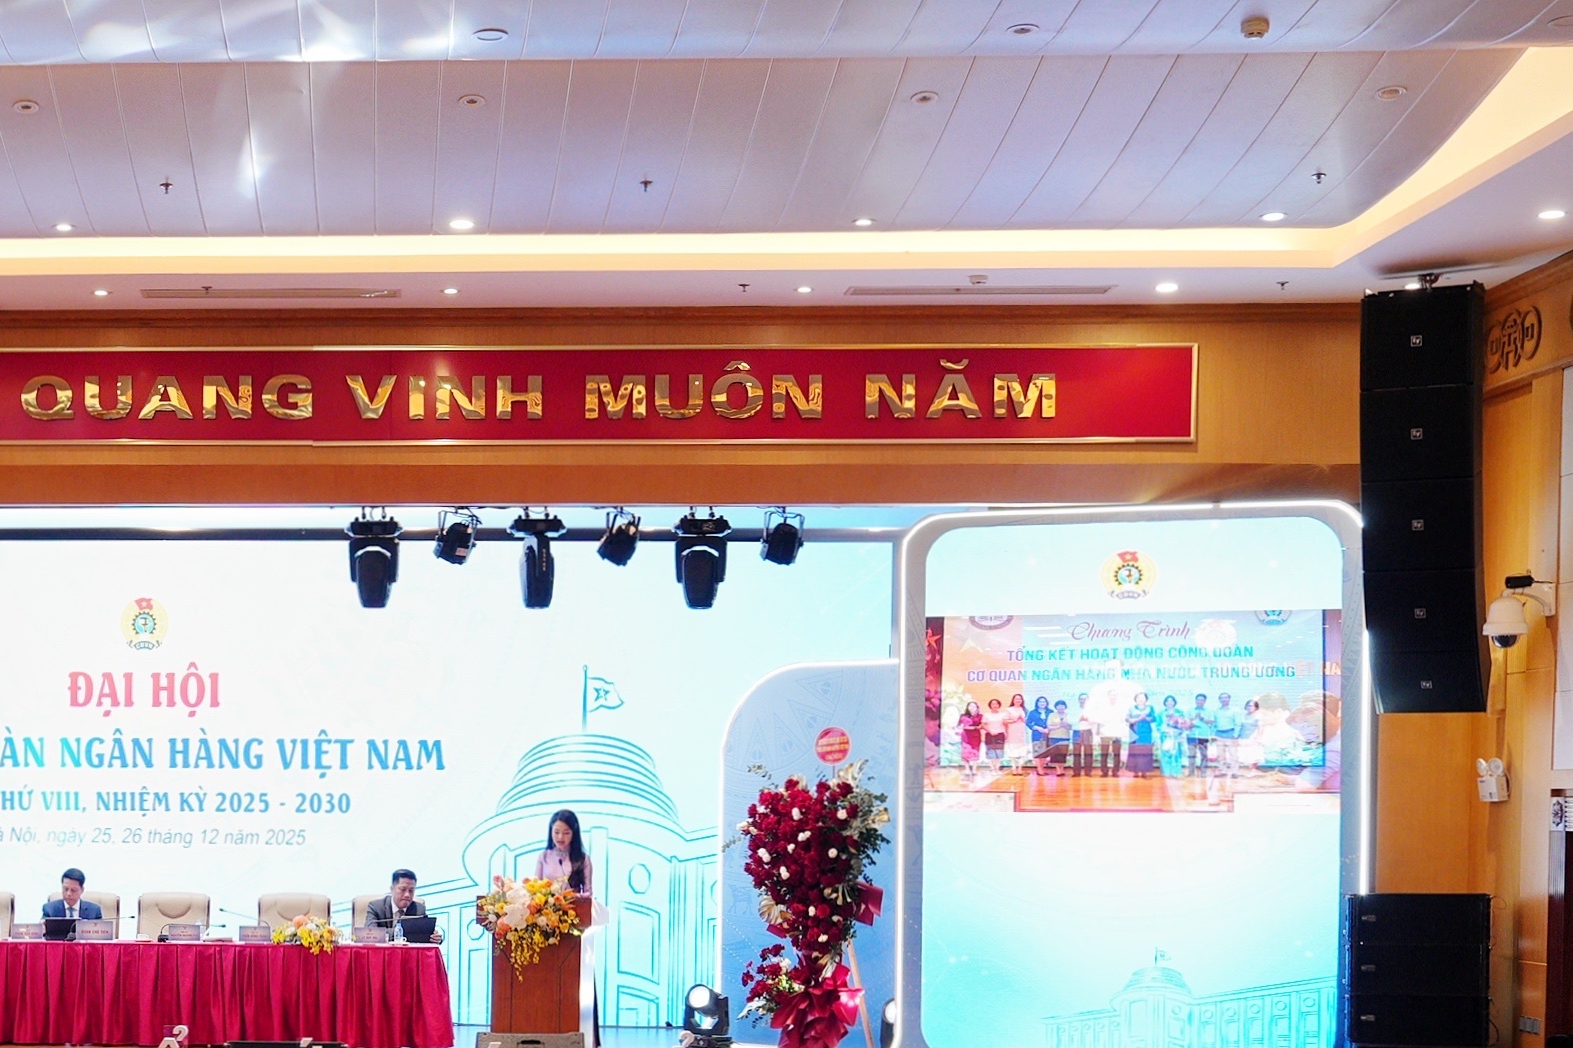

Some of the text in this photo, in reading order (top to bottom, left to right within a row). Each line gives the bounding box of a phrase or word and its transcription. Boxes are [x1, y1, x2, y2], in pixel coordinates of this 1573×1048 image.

[20, 374, 313, 421] QUANG
[346, 374, 543, 421] VINH
[584, 359, 823, 420] MUÔN
[864, 358, 1057, 420] NĂM
[67, 661, 221, 718] ĐẠI HỘI
[59, 727, 154, 768] NGÂN
[168, 727, 264, 770] HÀNG
[276, 729, 355, 779] VIỆT
[367, 738, 445, 770] NAM
[41, 790, 87, 813] VIII,
[96, 786, 170, 817] NHIỆM
[179, 786, 208, 813] KỲ
[215, 792, 270, 813] 2025
[295, 792, 351, 814] 2030
[47, 829, 86, 847] ngày
[122, 828, 142, 844] 26
[148, 828, 193, 848] tháng
[200, 829, 218, 845] 12
[225, 829, 260, 845] năm
[265, 829, 306, 845] 2025
